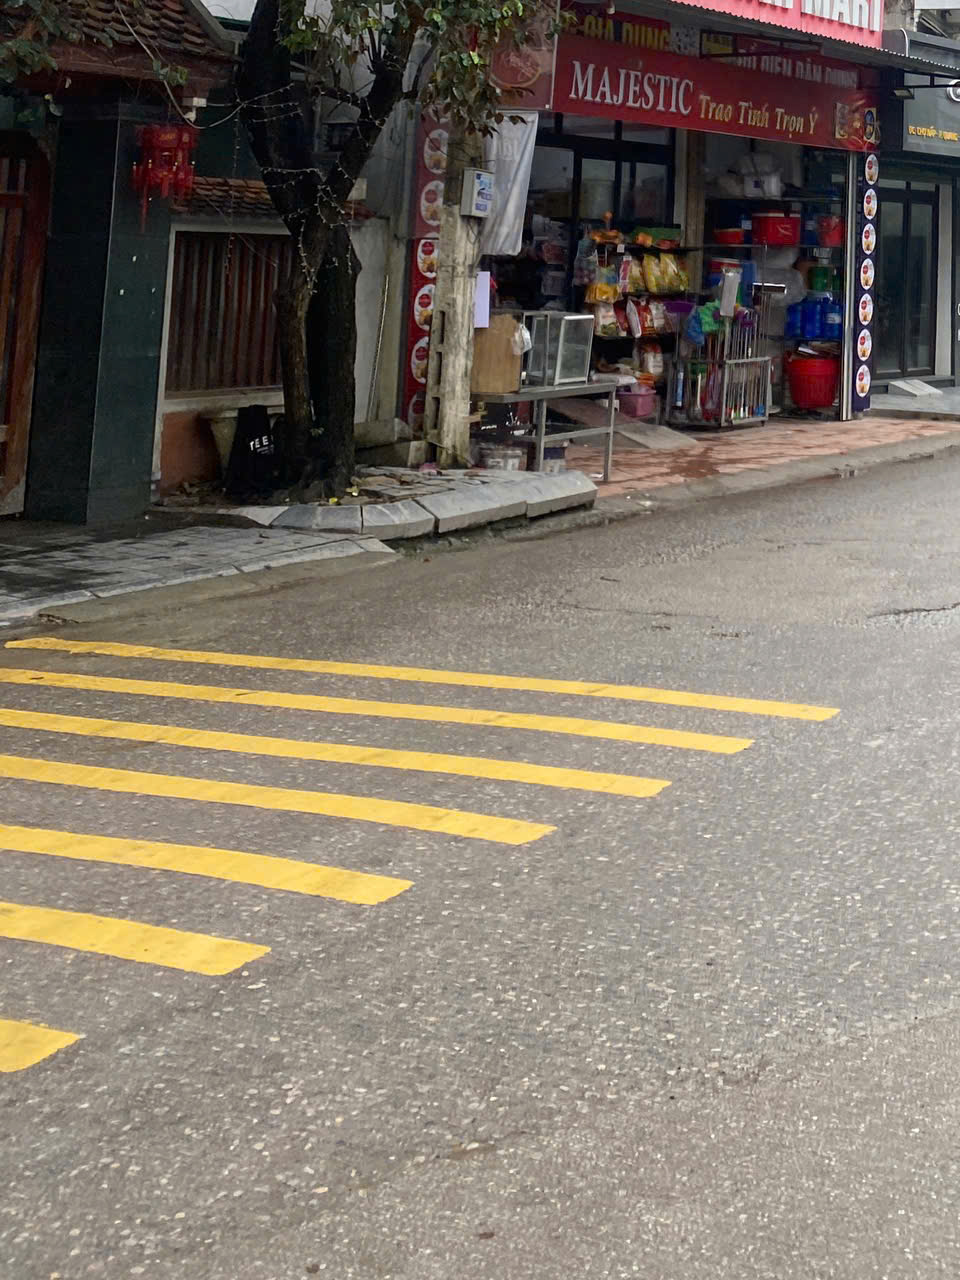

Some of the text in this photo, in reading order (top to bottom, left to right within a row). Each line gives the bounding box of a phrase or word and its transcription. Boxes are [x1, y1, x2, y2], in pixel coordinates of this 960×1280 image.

[568, 60, 693, 116] MAJESTIC
[699, 93, 819, 139] Trao Tình Trọn Ý
